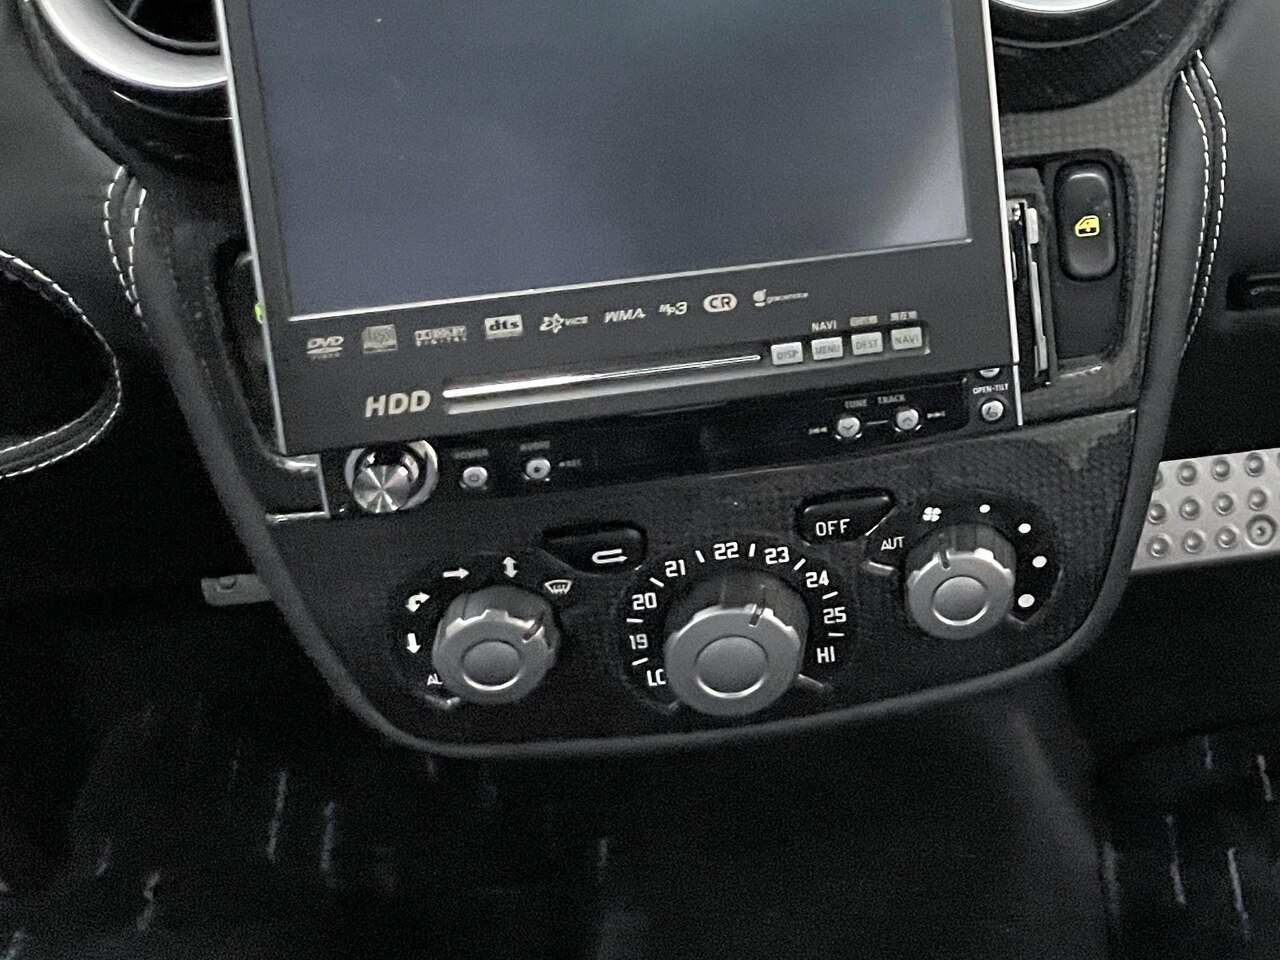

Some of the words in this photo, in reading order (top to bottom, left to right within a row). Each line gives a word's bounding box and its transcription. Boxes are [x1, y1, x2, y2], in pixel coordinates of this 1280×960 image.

[603, 308, 646, 323] WMA
[811, 320, 838, 332] NAVI
[307, 335, 344, 349] DVD
[855, 339, 878, 351] DEST
[365, 390, 431, 418] HDD
[814, 518, 851, 537] OFF
[714, 542, 740, 560] 22
[880, 536, 905, 551] AUT
[764, 547, 790, 565] 23
[664, 559, 687, 577] 21
[805, 570, 829, 588] 24
[632, 592, 658, 611] 20
[822, 607, 847, 624] 25
[628, 634, 649, 650] 19
[816, 646, 836, 664] HI
